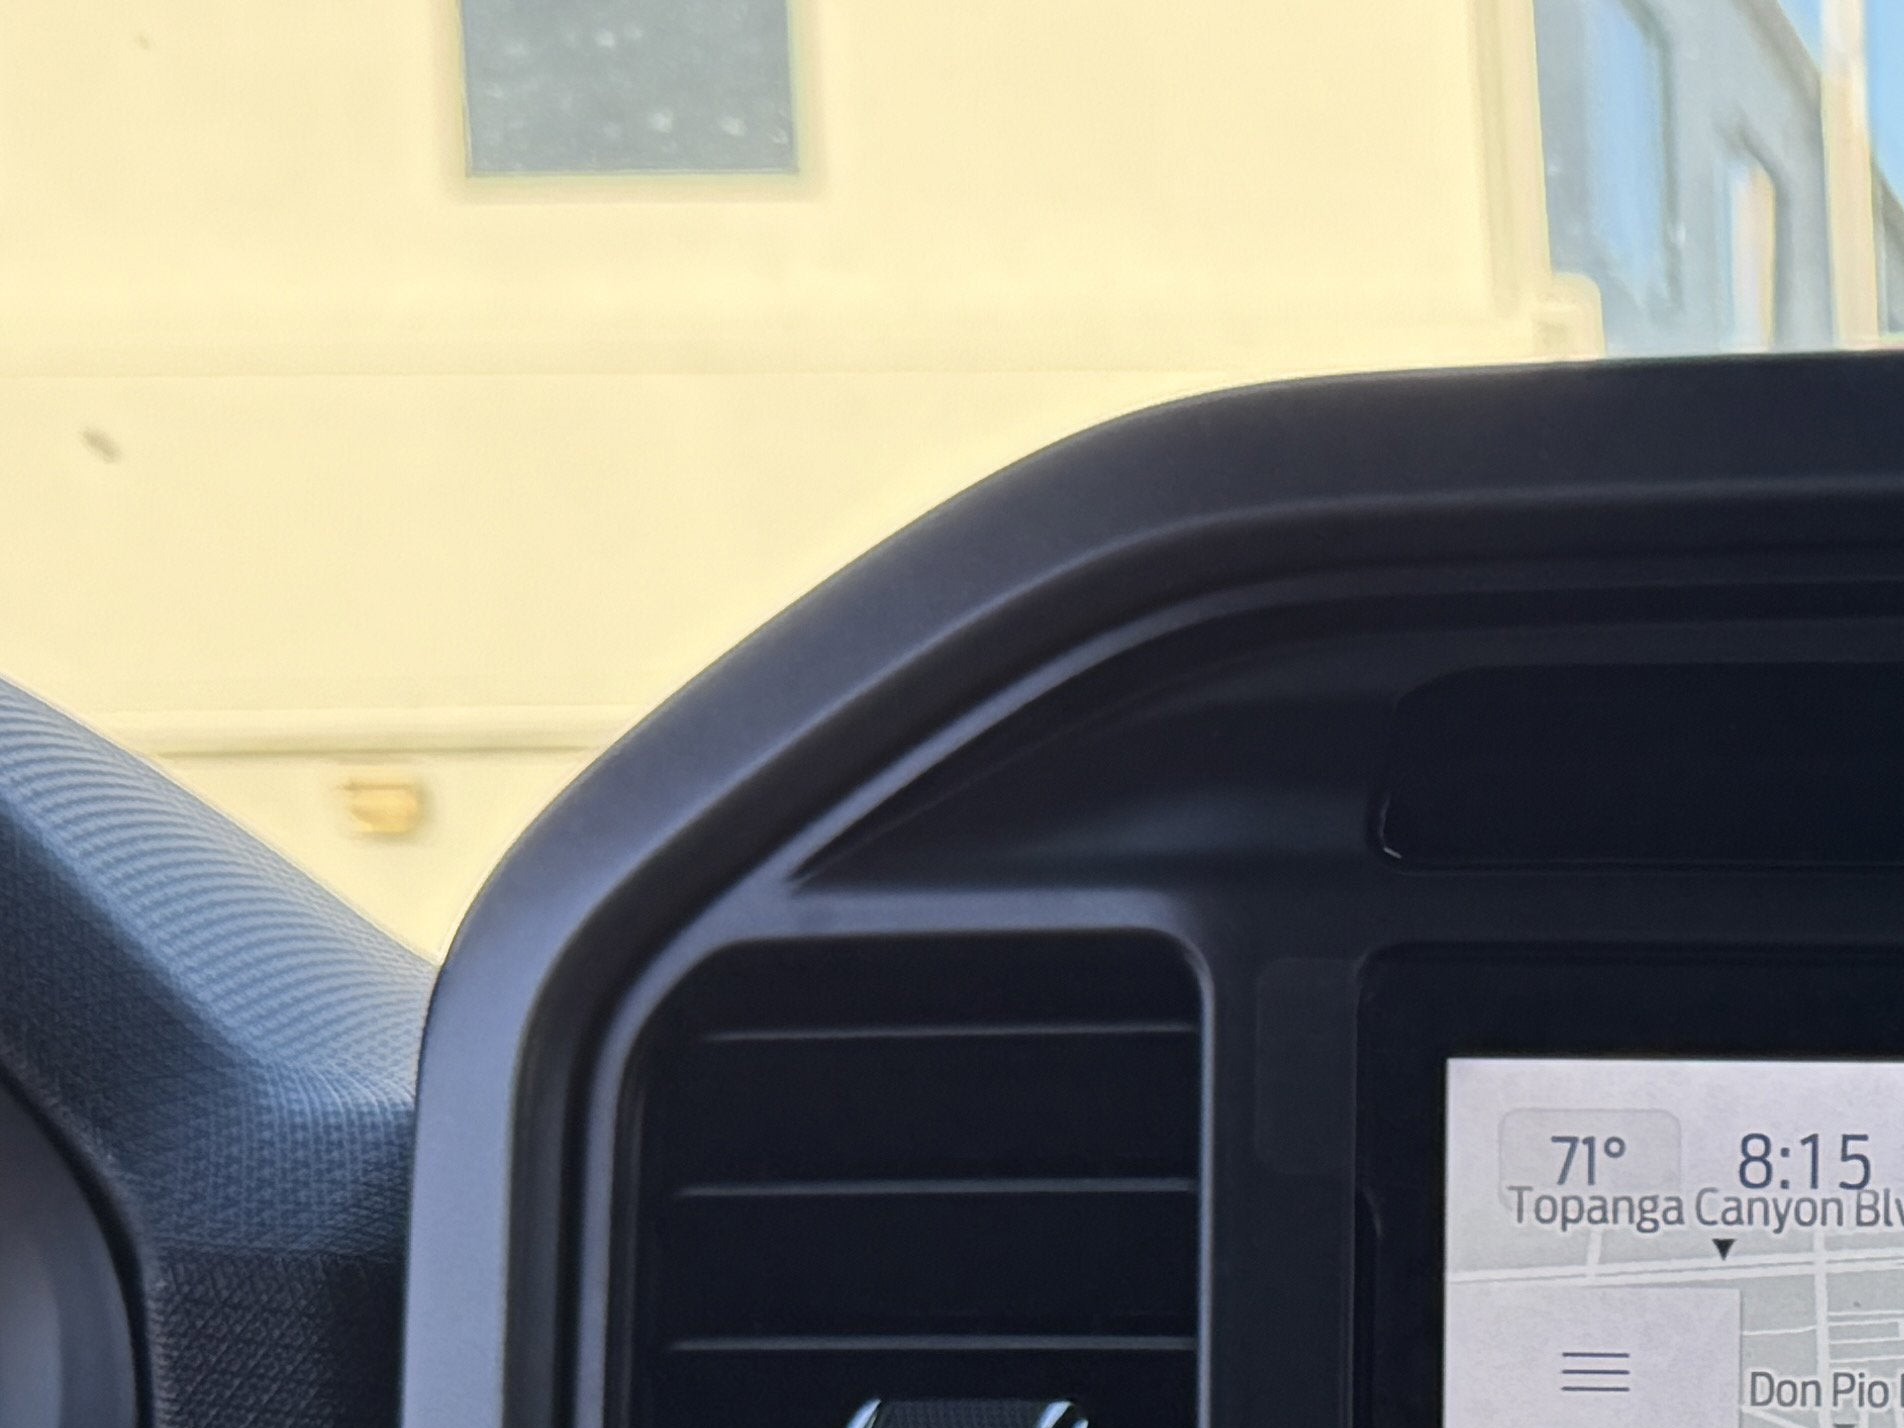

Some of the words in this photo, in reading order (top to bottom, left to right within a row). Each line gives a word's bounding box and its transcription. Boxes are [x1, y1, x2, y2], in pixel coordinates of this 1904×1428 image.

[1551, 1135, 1627, 1187] 71°
[1738, 1132, 1872, 1191] 8:15
[1507, 1185, 1685, 1234] Topanga
[1695, 1187, 1844, 1234] Canyon
[1749, 1372, 1822, 1407] Don
[1834, 1371, 1889, 1408] Pio
